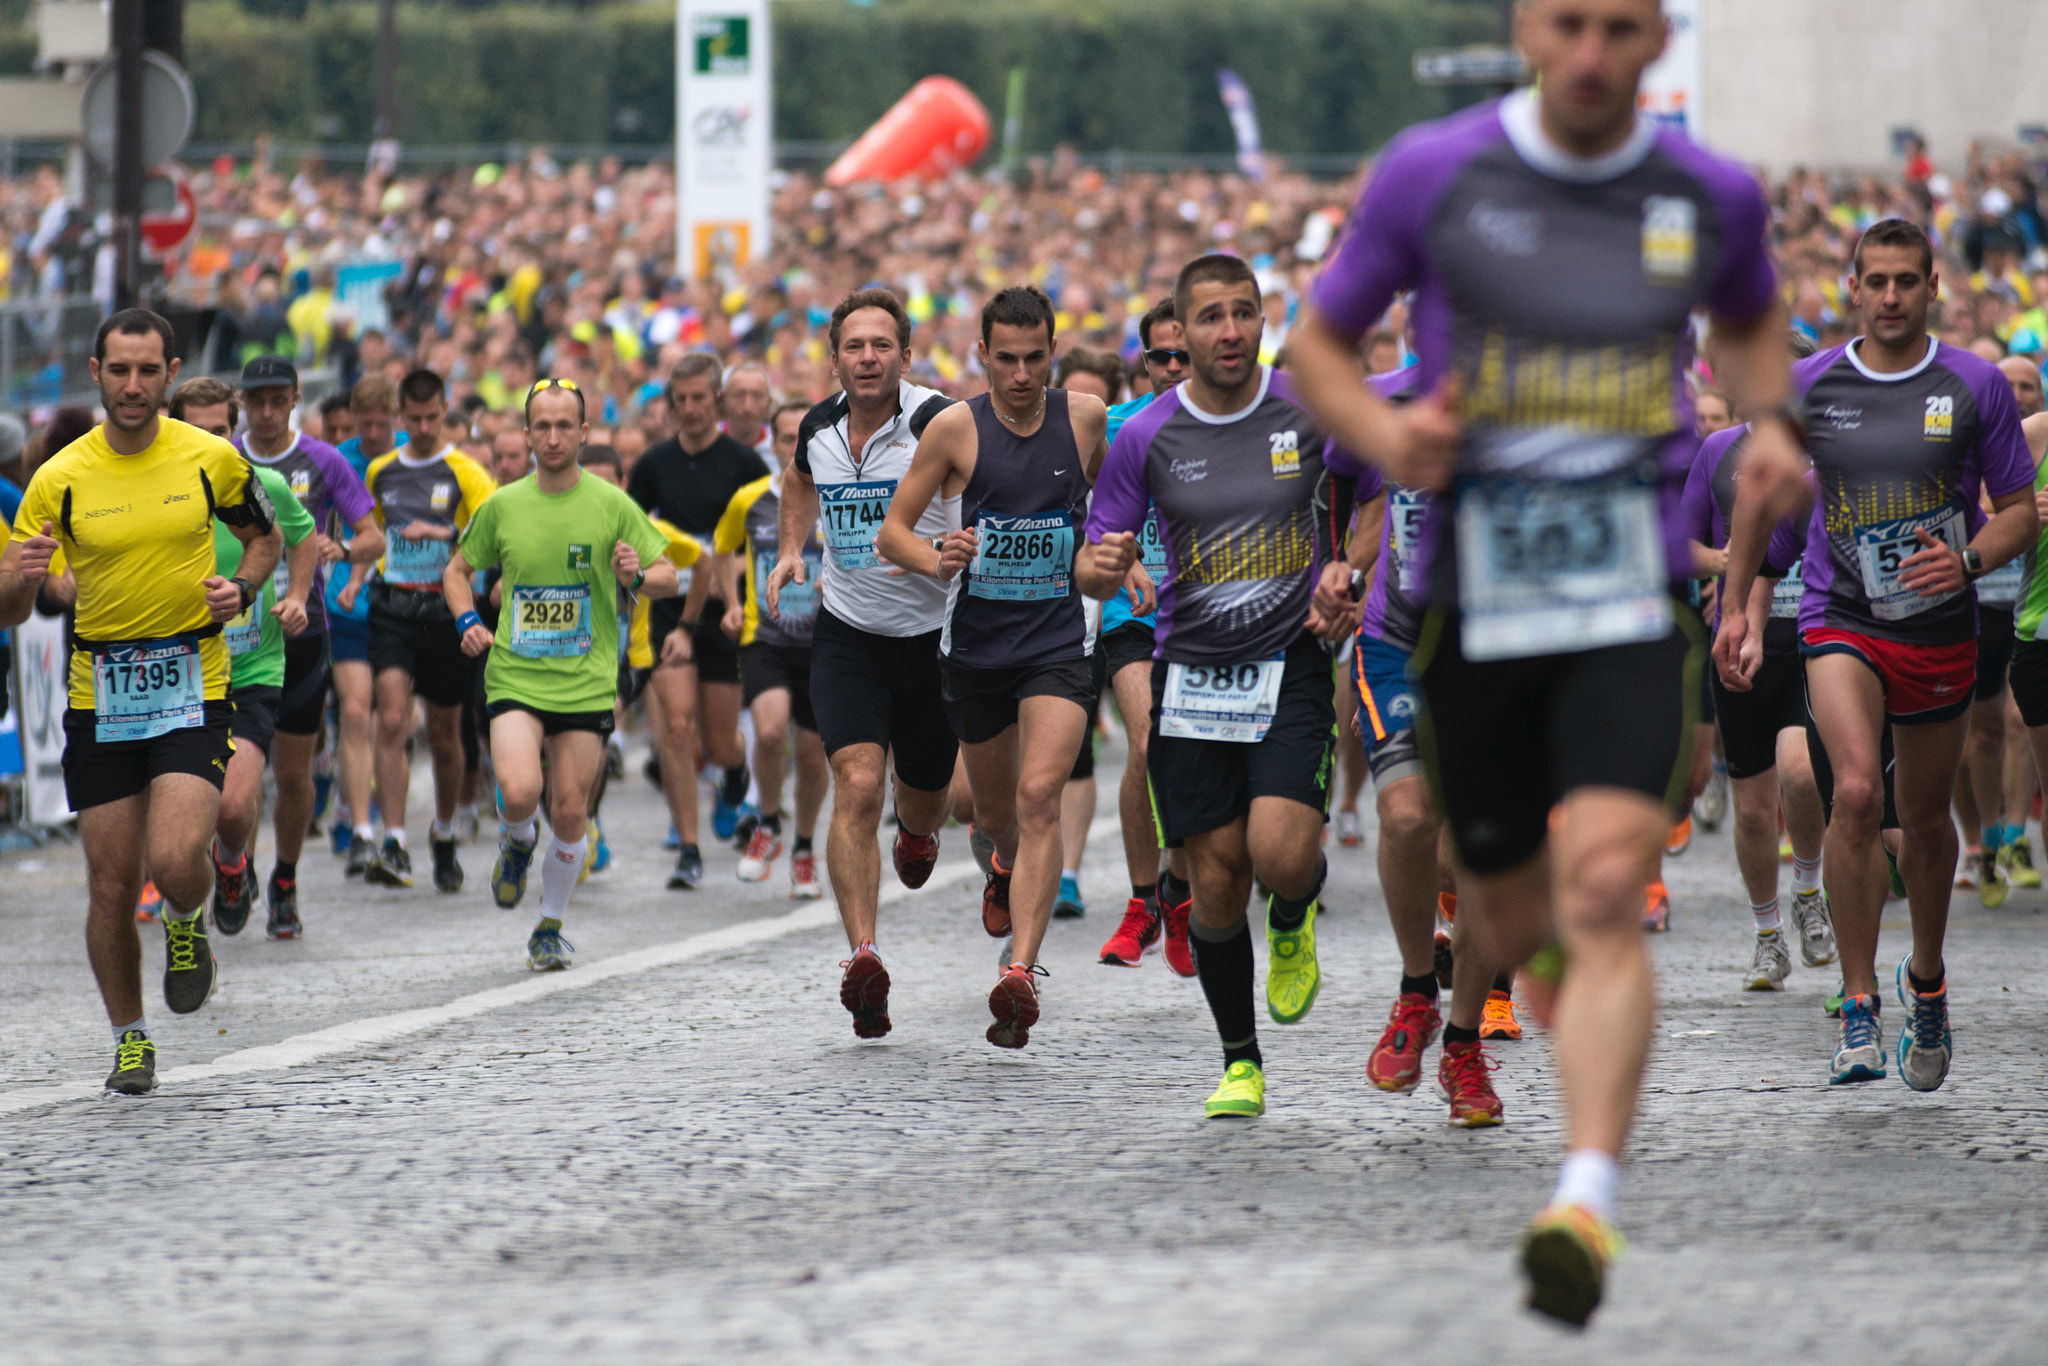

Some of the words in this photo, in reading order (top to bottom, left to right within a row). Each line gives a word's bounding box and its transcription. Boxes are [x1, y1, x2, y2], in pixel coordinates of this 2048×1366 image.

[1925, 396, 1952, 415] 20
[1269, 430, 1298, 453] 20
[984, 532, 1054, 560] 22866
[523, 602, 574, 623] 2928
[105, 659, 180, 694] 17395
[1185, 662, 1259, 692] 580
[150, 711, 160, 719] de
[162, 708, 182, 718] Paris
[184, 704, 202, 714] 2014
